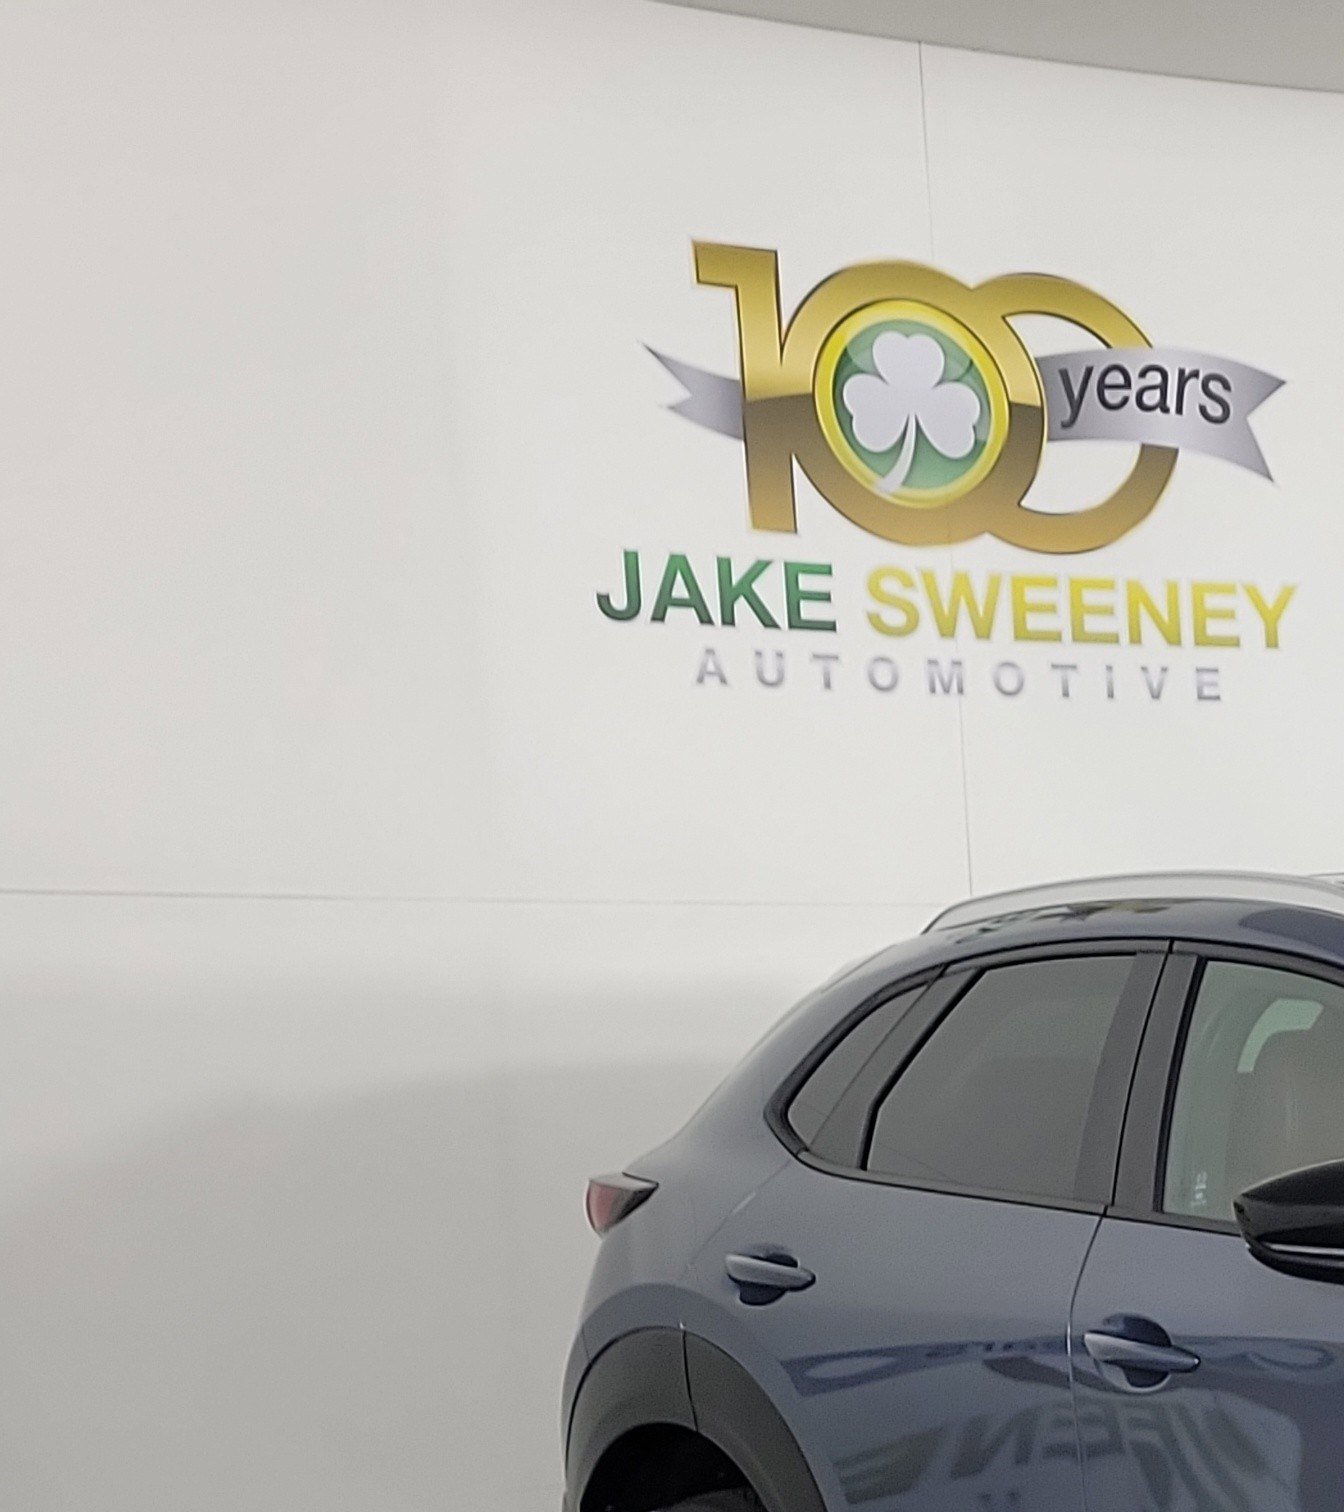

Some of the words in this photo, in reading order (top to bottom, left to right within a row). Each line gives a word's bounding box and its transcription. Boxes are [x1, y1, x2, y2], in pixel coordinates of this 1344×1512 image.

[1058, 362, 1232, 428] years
[597, 550, 838, 633] JAKE
[864, 565, 1298, 649] SWEENEY
[696, 648, 1223, 702] AUTOMOTIVE
